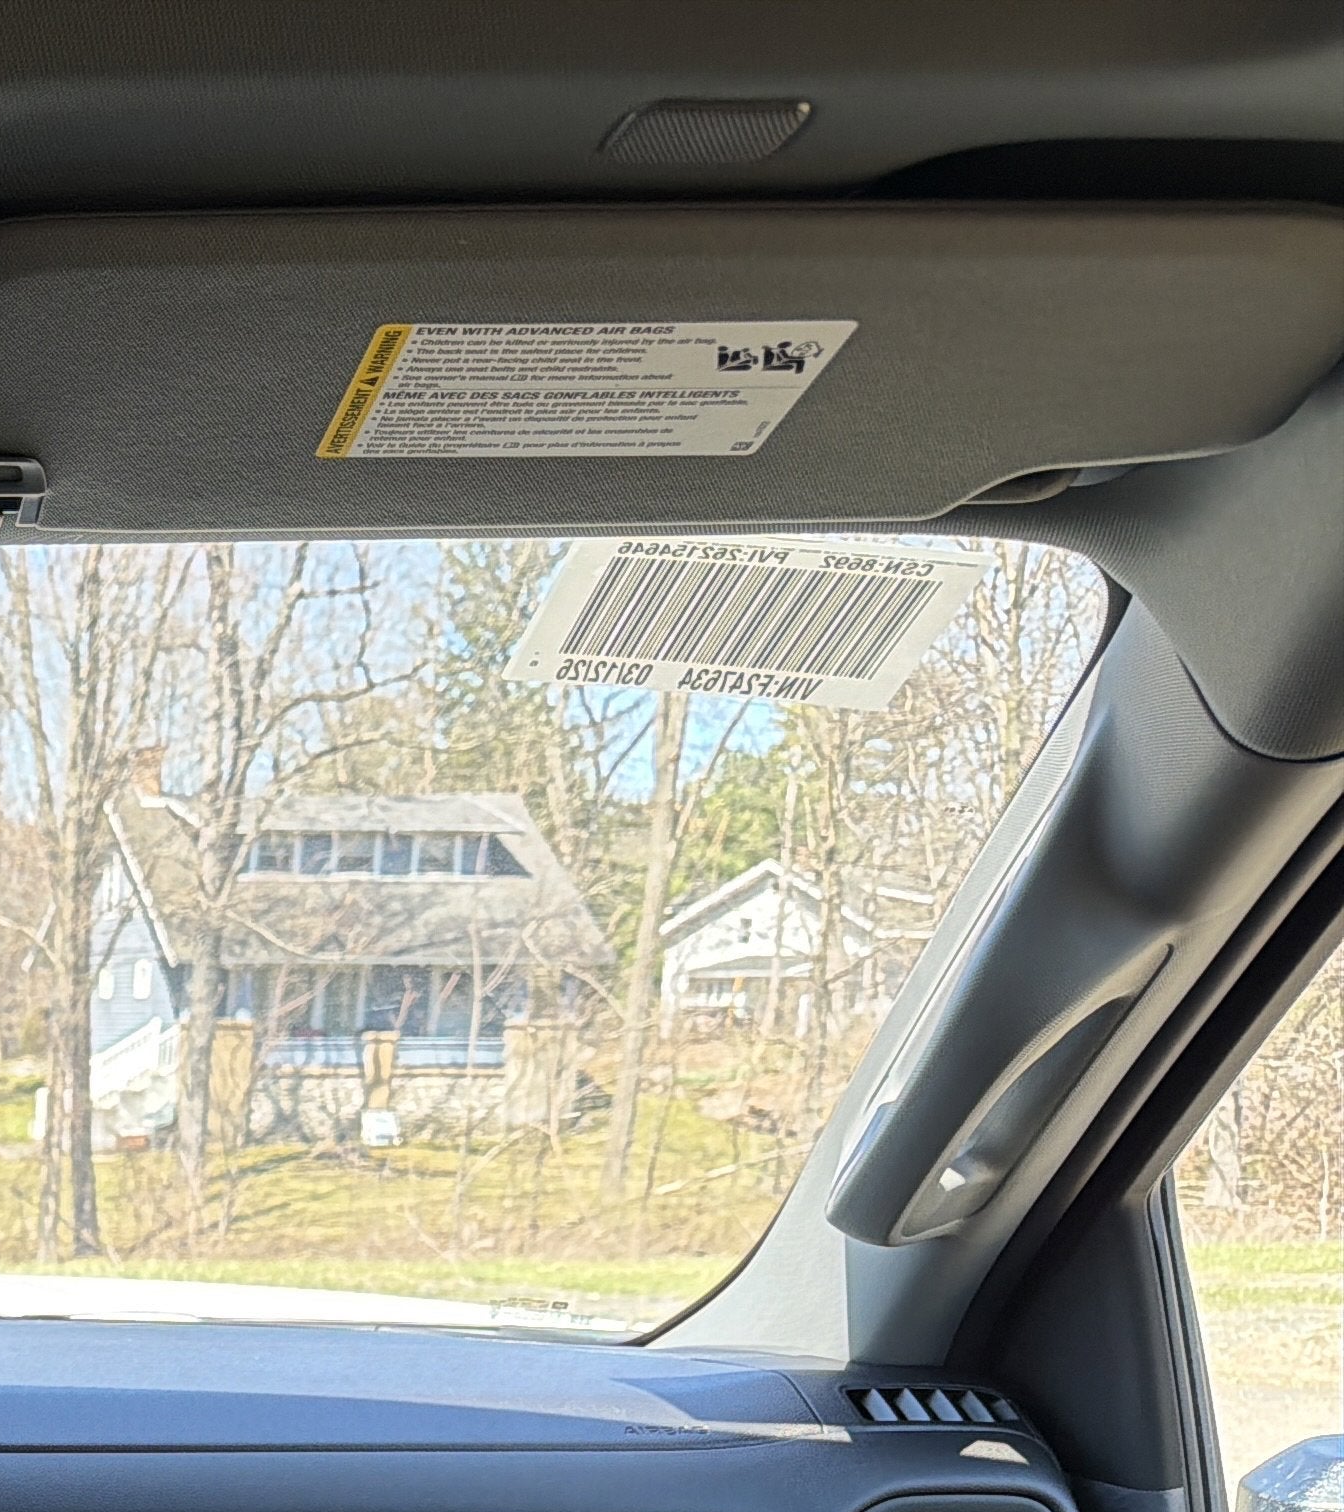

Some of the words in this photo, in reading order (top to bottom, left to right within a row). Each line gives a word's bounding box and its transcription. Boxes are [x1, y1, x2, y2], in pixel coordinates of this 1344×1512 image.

[415, 327, 458, 336] EVEN
[462, 327, 502, 336] WITH
[505, 327, 595, 336] ADVANCED
[596, 327, 626, 335] AIR
[629, 326, 675, 335] BAGS
[365, 330, 402, 374] WARNING
[431, 391, 469, 400] AVEC
[471, 391, 498, 400] DES
[500, 391, 541, 400] SACS
[543, 391, 637, 400] GONFLABLES
[639, 390, 740, 400] INTELLIGENTS
[326, 388, 373, 454] AVERTISSEMENT
